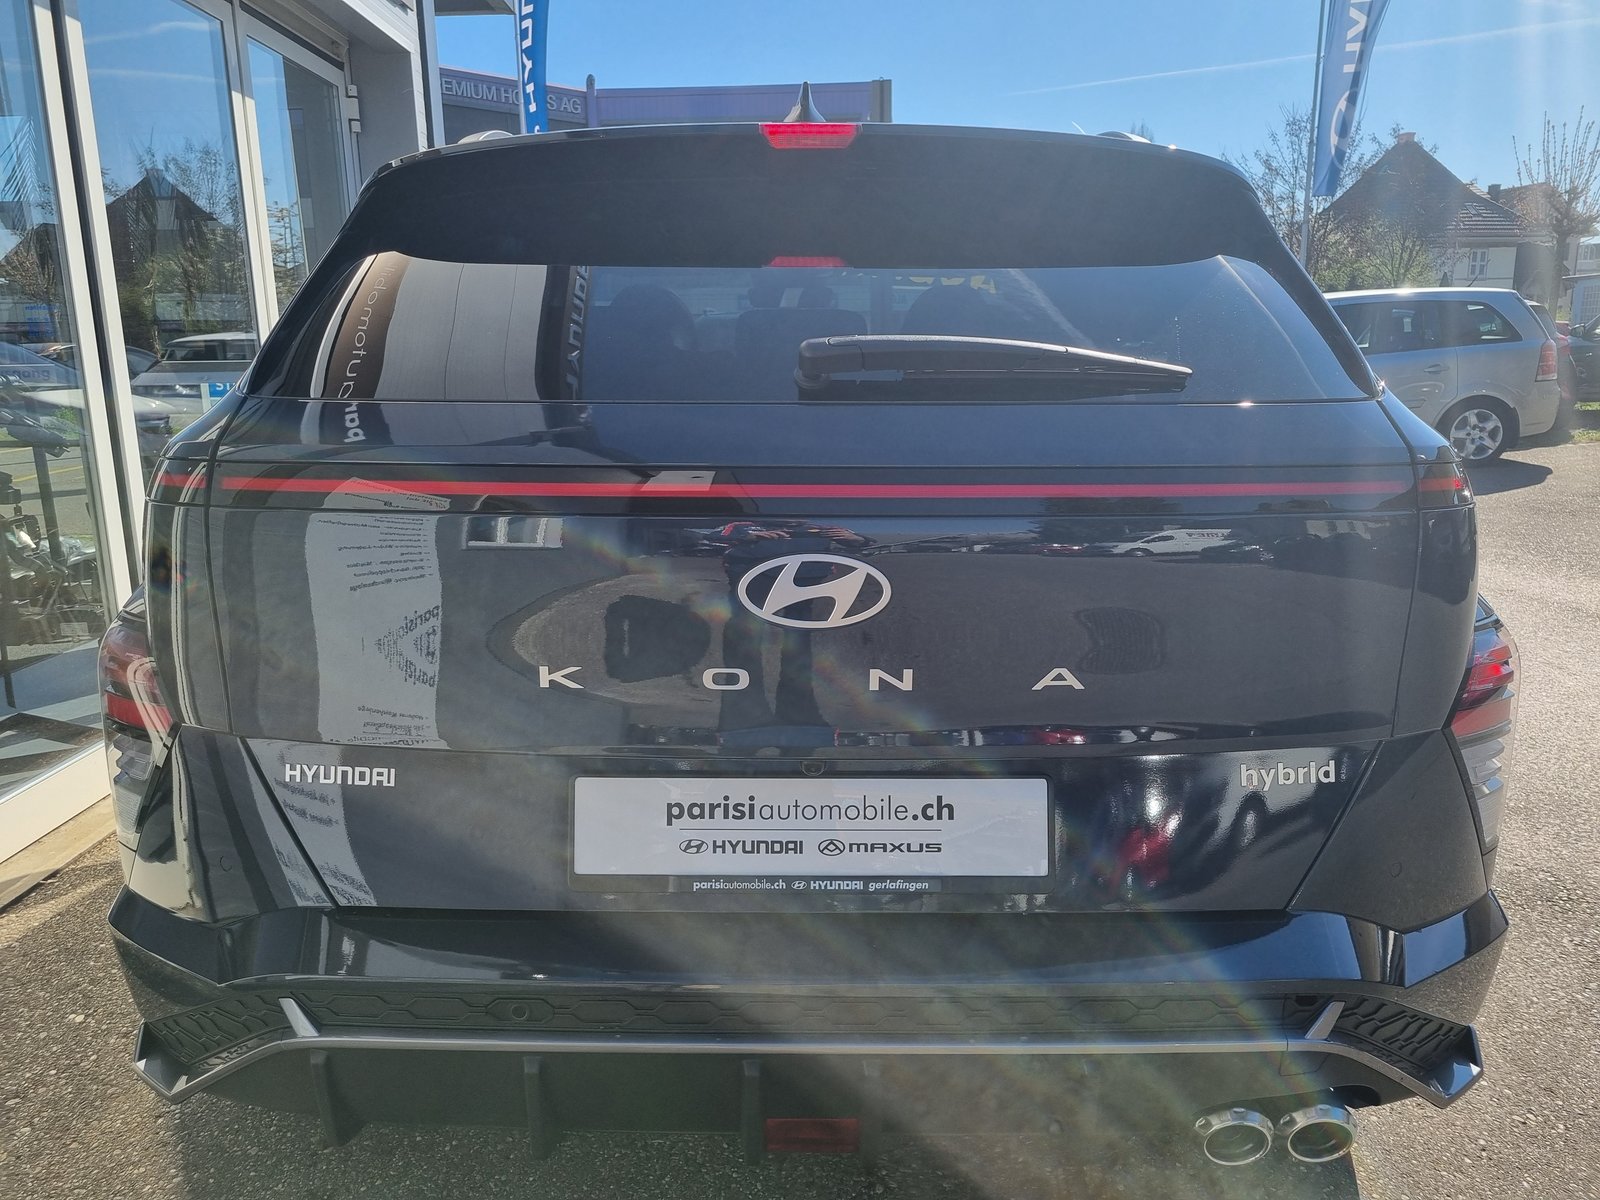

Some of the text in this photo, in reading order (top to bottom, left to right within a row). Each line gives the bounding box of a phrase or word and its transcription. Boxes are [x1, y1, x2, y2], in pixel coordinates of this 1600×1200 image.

[561, 97, 582, 114] AG
[538, 666, 1085, 692] KONA
[285, 763, 396, 787] HYUNDAI
[1240, 759, 1336, 791] hybrid
[666, 795, 955, 826] parisiautomobile.ch
[712, 840, 942, 855] HYUNDAI MAXUS
[693, 879, 929, 891] parisiautomobile.ch HYUNDAI gerlafingen
